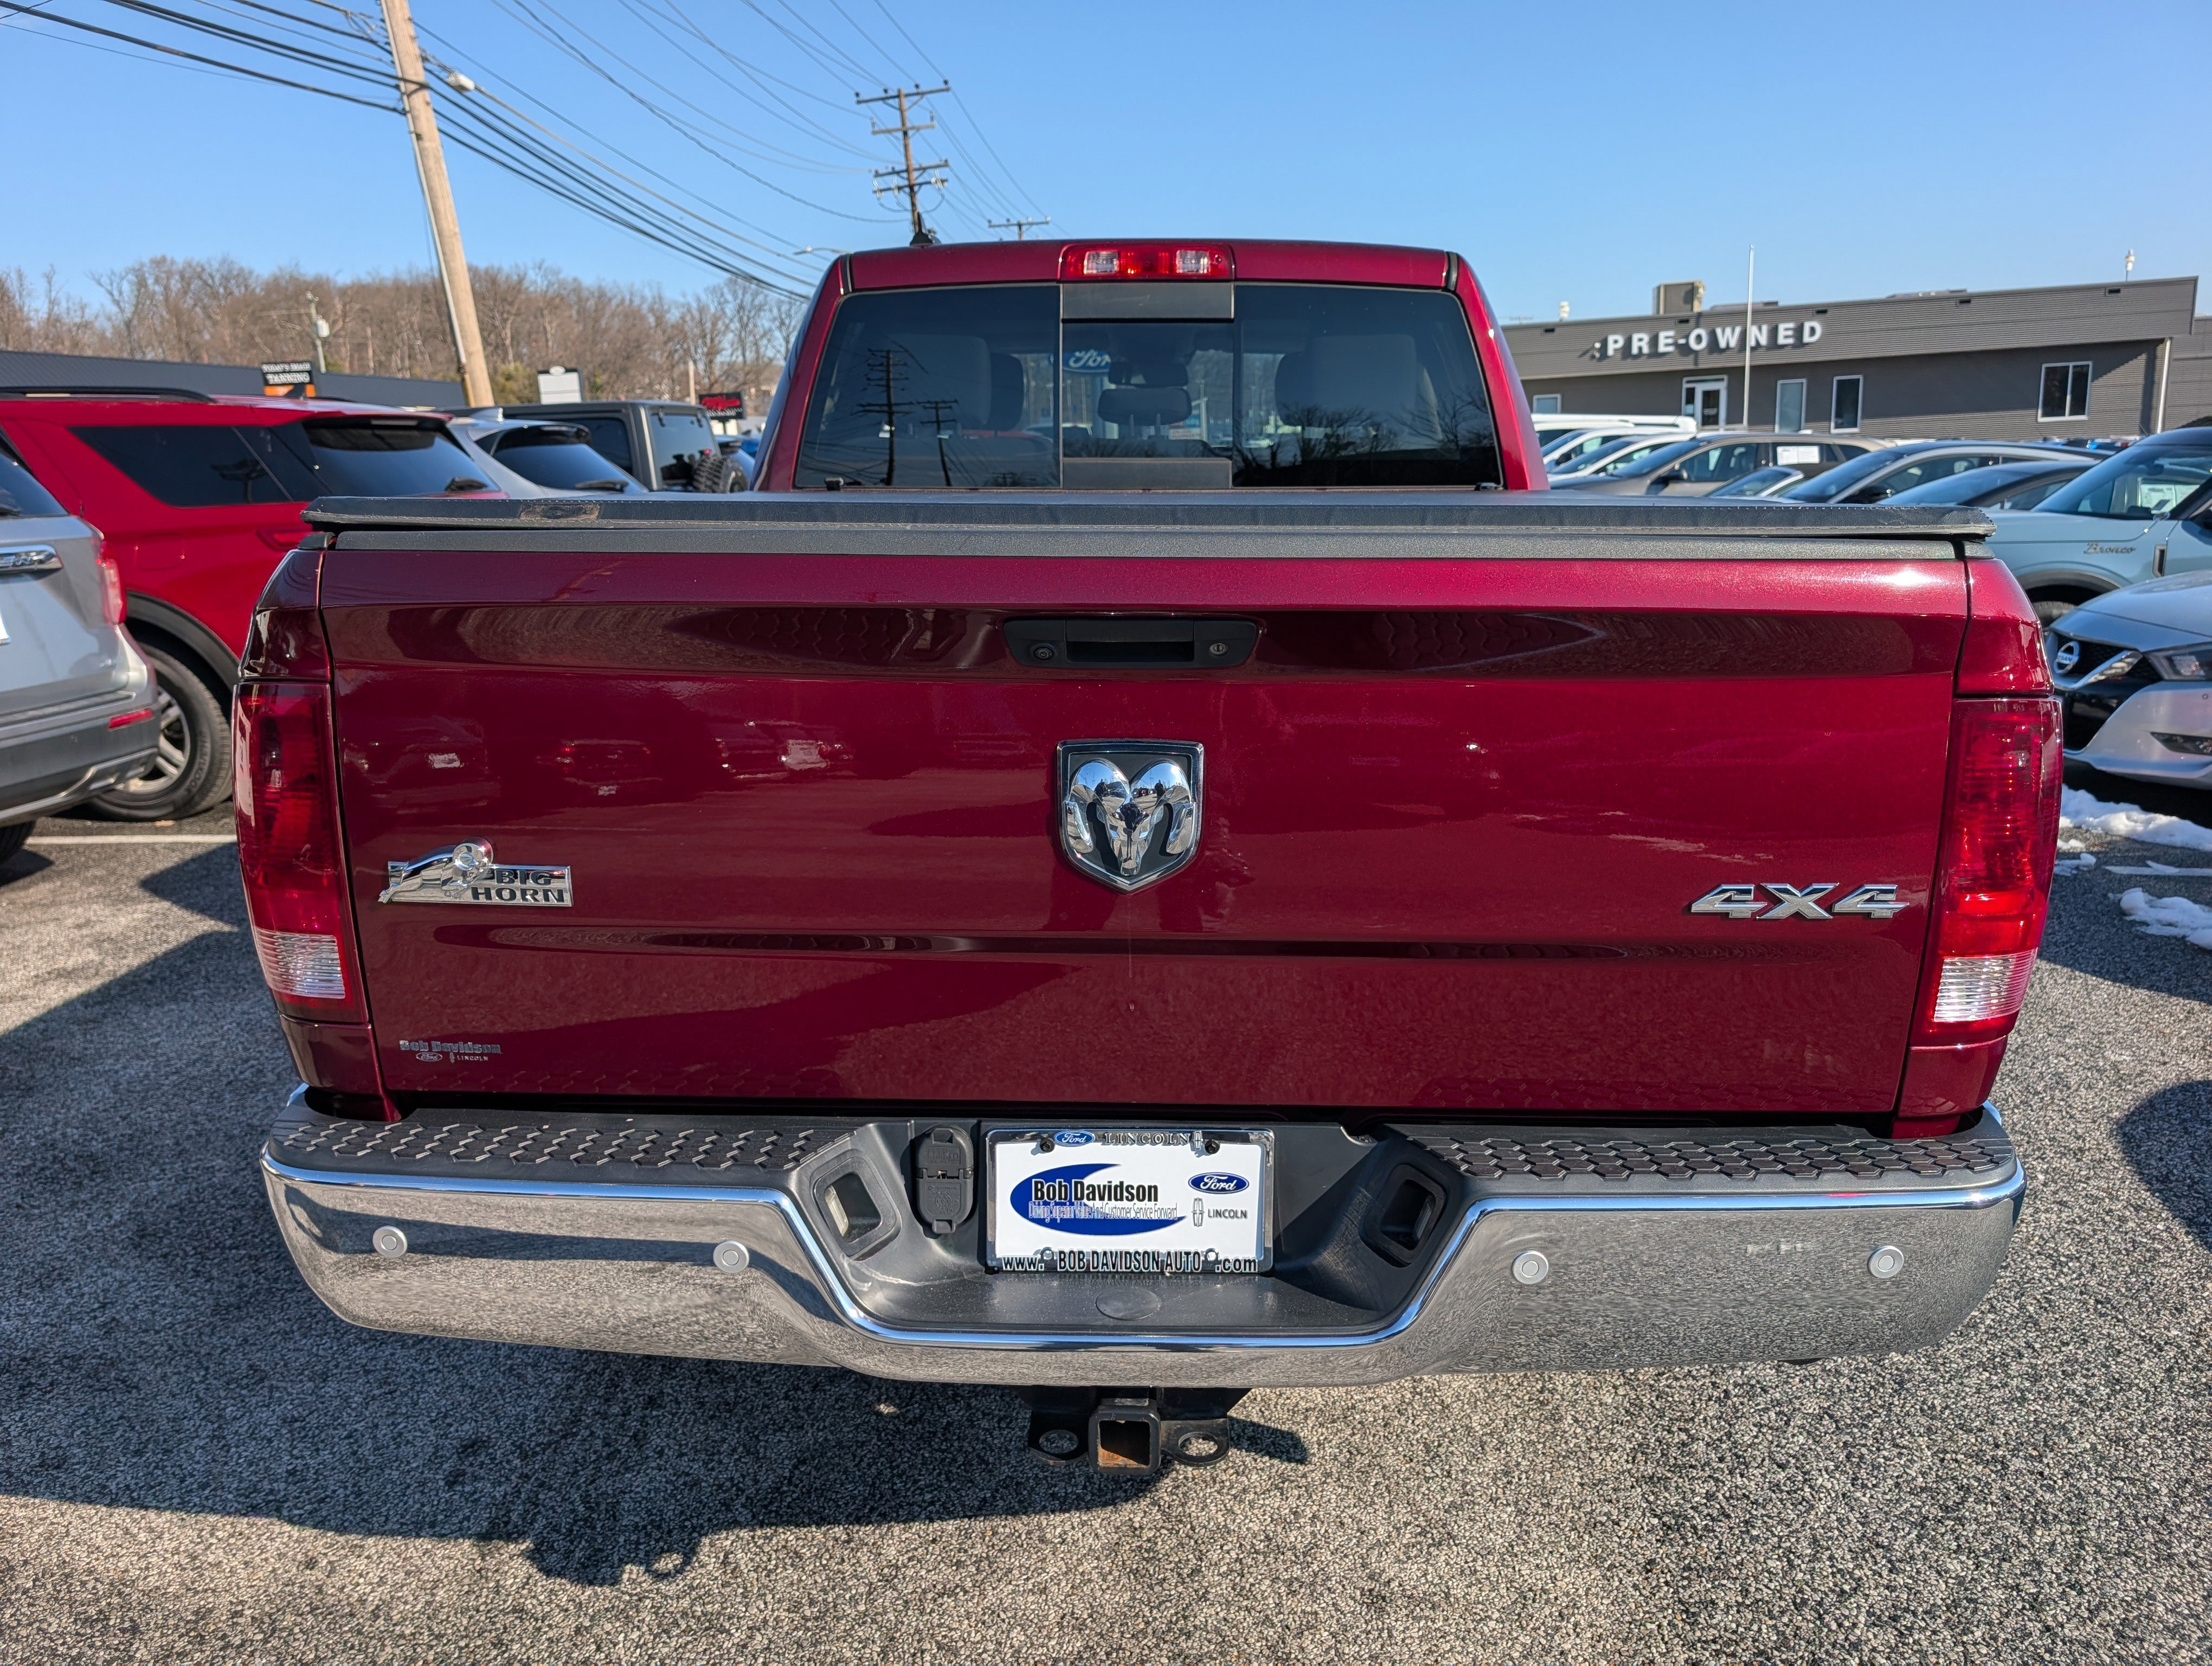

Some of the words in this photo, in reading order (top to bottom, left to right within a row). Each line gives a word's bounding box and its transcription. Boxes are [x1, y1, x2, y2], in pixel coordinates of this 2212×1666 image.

[1606, 321, 1823, 356] PRE-OWNED
[1069, 350, 1111, 367] For
[496, 870, 552, 885] BIG
[471, 887, 565, 902] HORN
[400, 1040, 428, 1051] Bob
[431, 1041, 502, 1054] Davidson
[1062, 1133, 1086, 1143] Ford
[1105, 1132, 1191, 1145] LINCOLN
[1200, 1175, 1237, 1190] Ford
[1033, 1180, 1069, 1202] Bob
[1073, 1180, 1159, 1202] Davidson
[1028, 1201, 1050, 1223] Driving
[1050, 1201, 1074, 1223] Superior
[1091, 1202, 1104, 1219] And
[1104, 1202, 1132, 1219] Customer
[1133, 1202, 1153, 1219] Service
[1154, 1202, 1178, 1220] Forward
[1207, 1208, 1248, 1219] LINCOLN
[1057, 1250, 1086, 1272] BOB
[1090, 1250, 1160, 1272] DAVIDSON
[1164, 1250, 1202, 1272] AUTO
